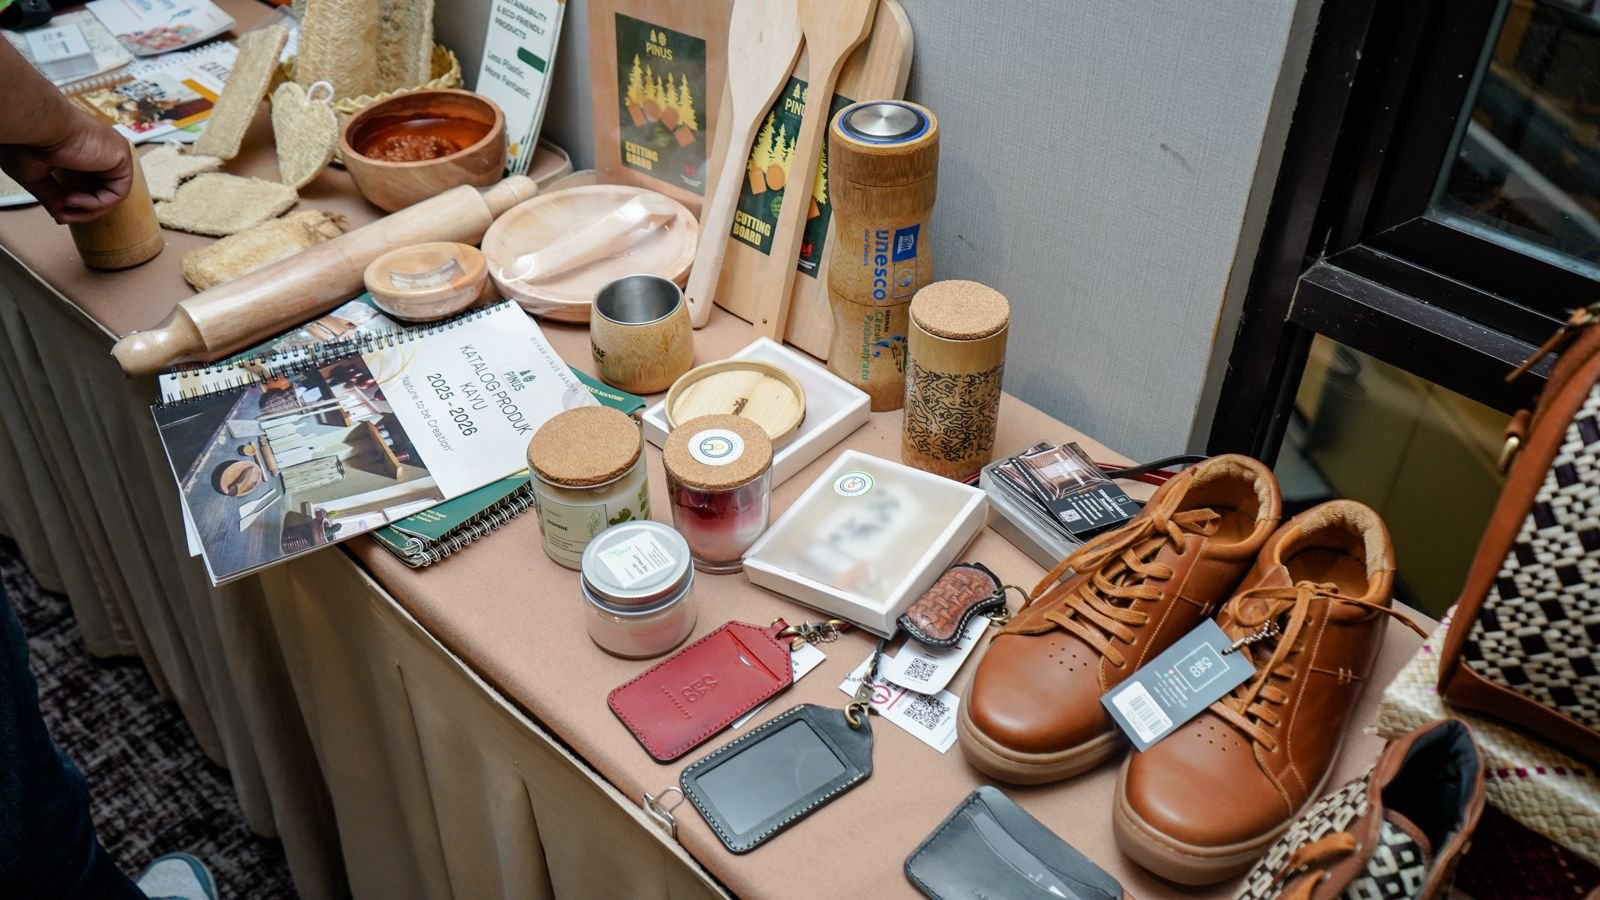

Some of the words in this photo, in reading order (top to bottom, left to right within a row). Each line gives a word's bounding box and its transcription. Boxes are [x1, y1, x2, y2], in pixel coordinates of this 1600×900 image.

[645, 41, 673, 60] PINUS
[625, 141, 659, 162] CUTTING
[625, 152, 653, 170] BOARD
[733, 222, 763, 246] BOARD
[735, 210, 772, 238] CUTTING
[872, 229, 890, 301] unesco
[459, 344, 501, 392] KATALOG
[494, 392, 534, 437] PRODUK
[503, 371, 526, 393] PINUS
[426, 373, 455, 401] 2025
[450, 407, 478, 437] 2026
[459, 382, 489, 411] KAYU
[420, 407, 432, 419] be
